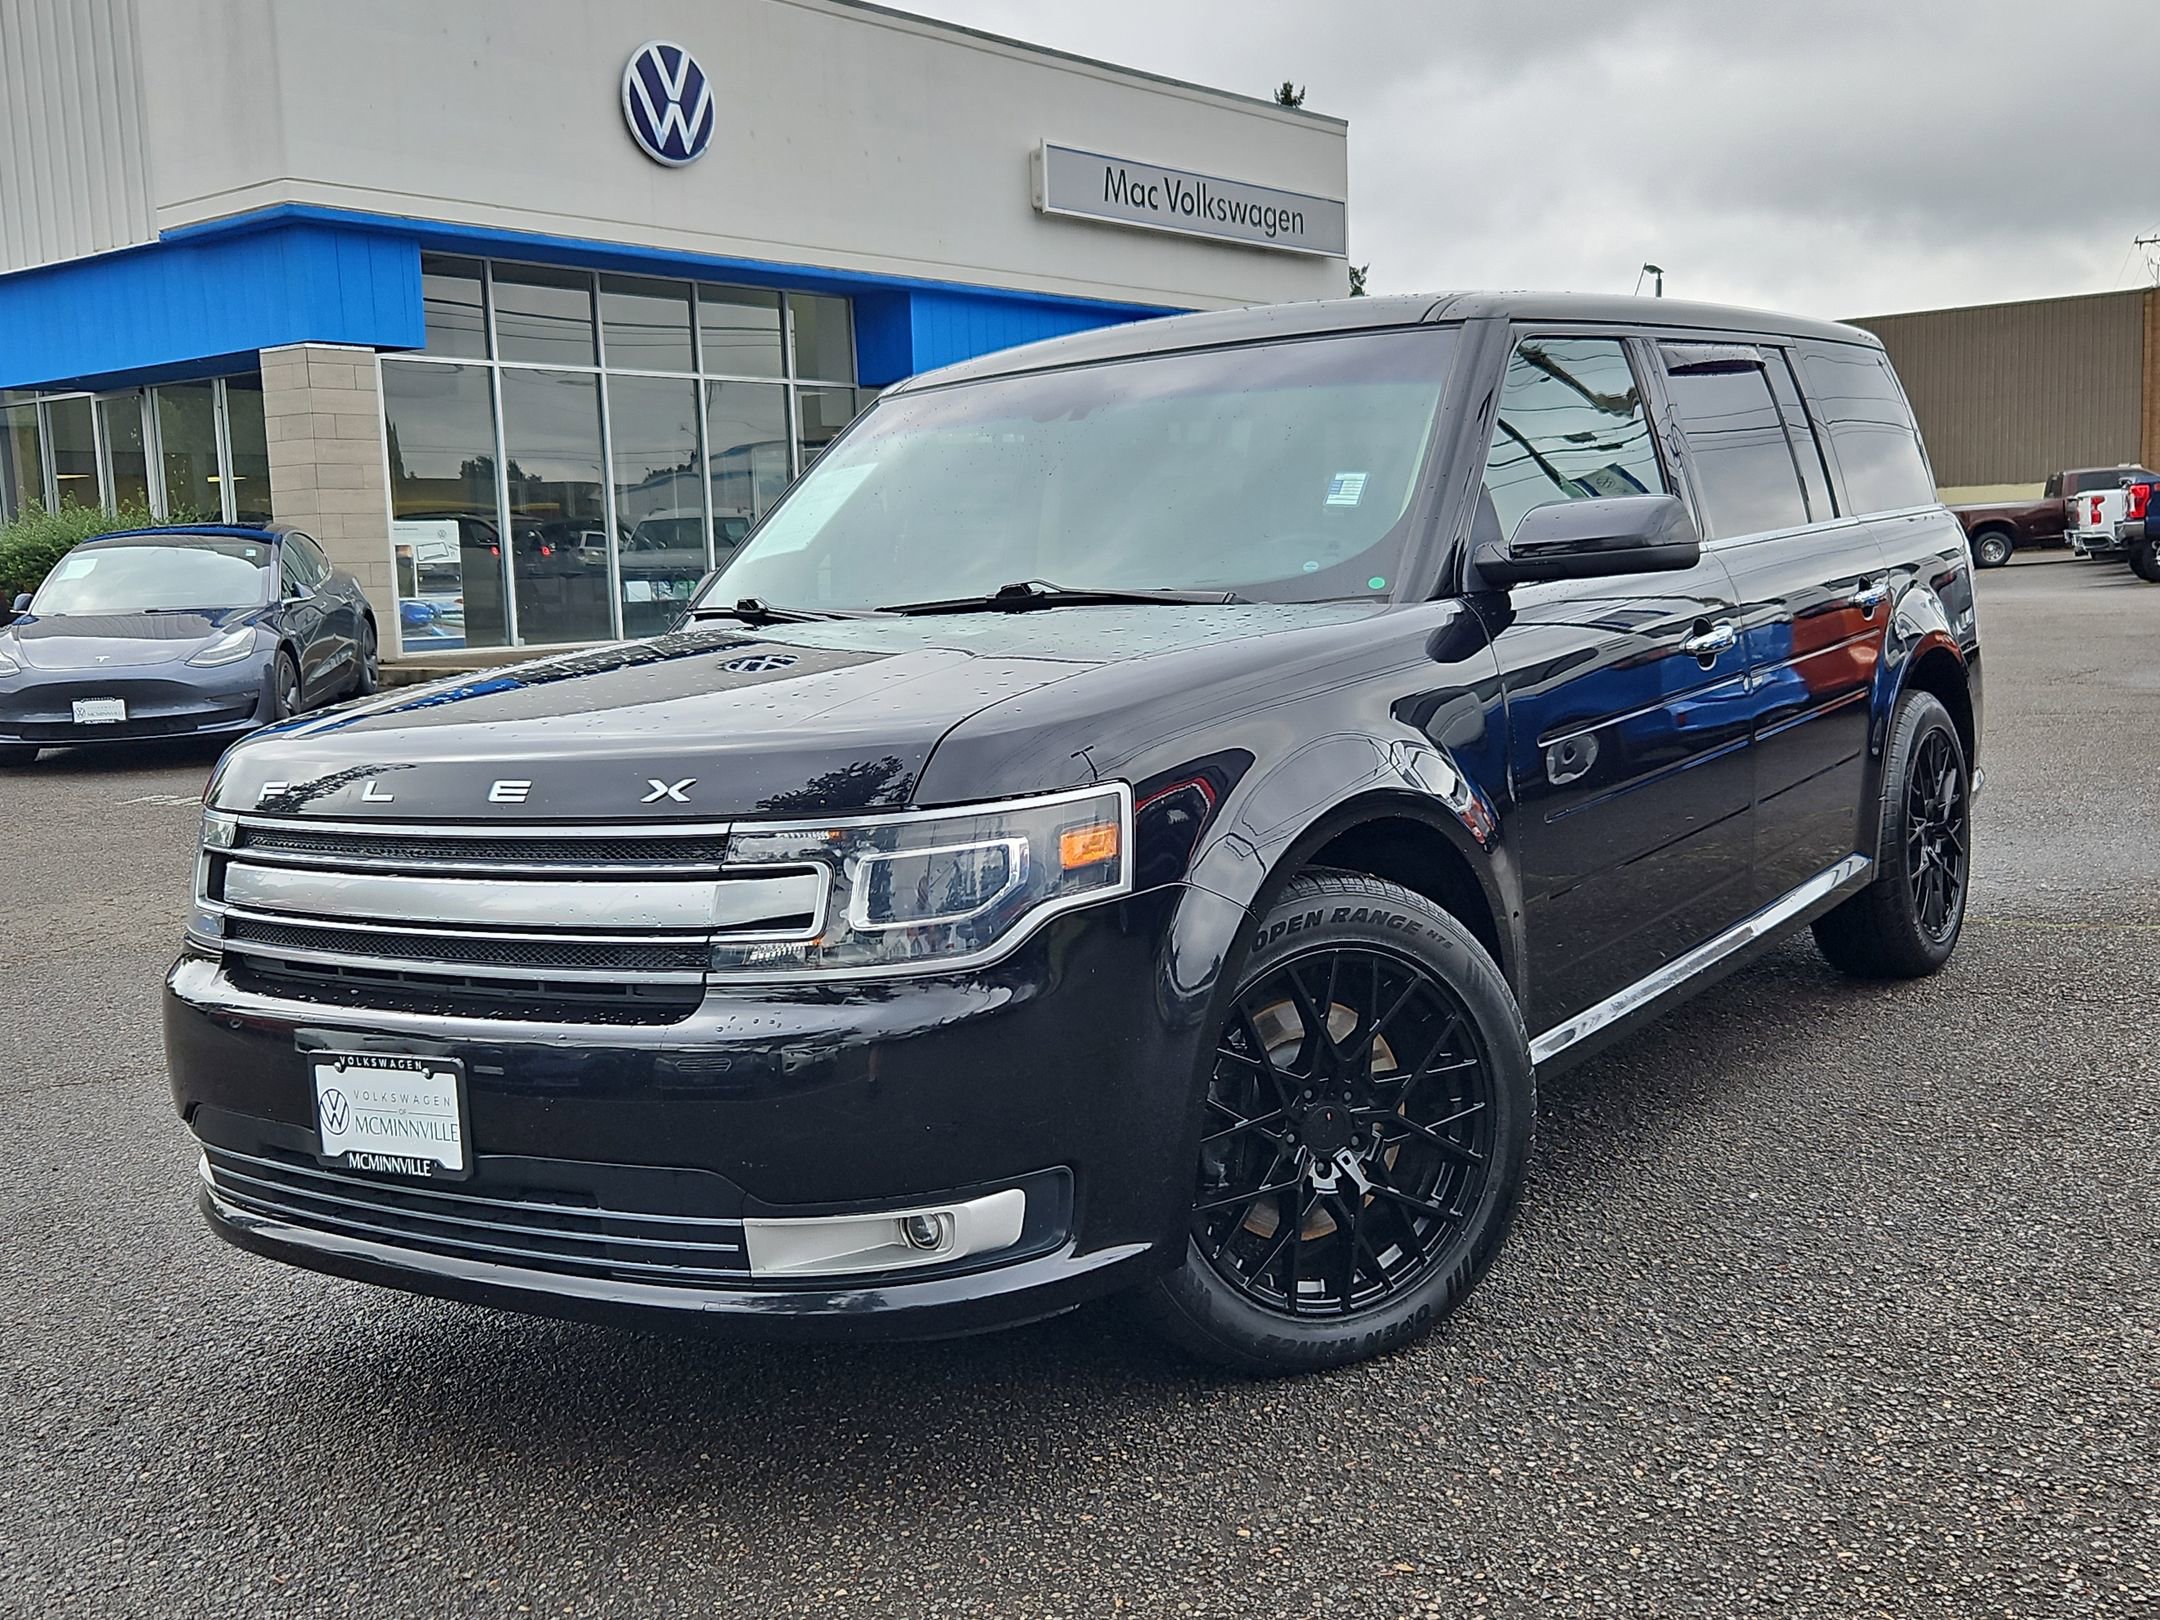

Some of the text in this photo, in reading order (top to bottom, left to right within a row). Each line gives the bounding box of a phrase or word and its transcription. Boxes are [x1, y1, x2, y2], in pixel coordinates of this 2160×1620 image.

[1103, 166, 1305, 238] Mac Volkswagen
[258, 778, 697, 804] FLEX
[1251, 908, 1324, 952] OPEN
[1330, 906, 1424, 937] RANGE
[339, 1055, 423, 1070] VOLKSWAGEN
[353, 1089, 451, 1107] VOLKSWAGEN
[355, 1115, 460, 1142] MCMINNVILLE
[349, 1152, 432, 1177] MCMINNVILLE
